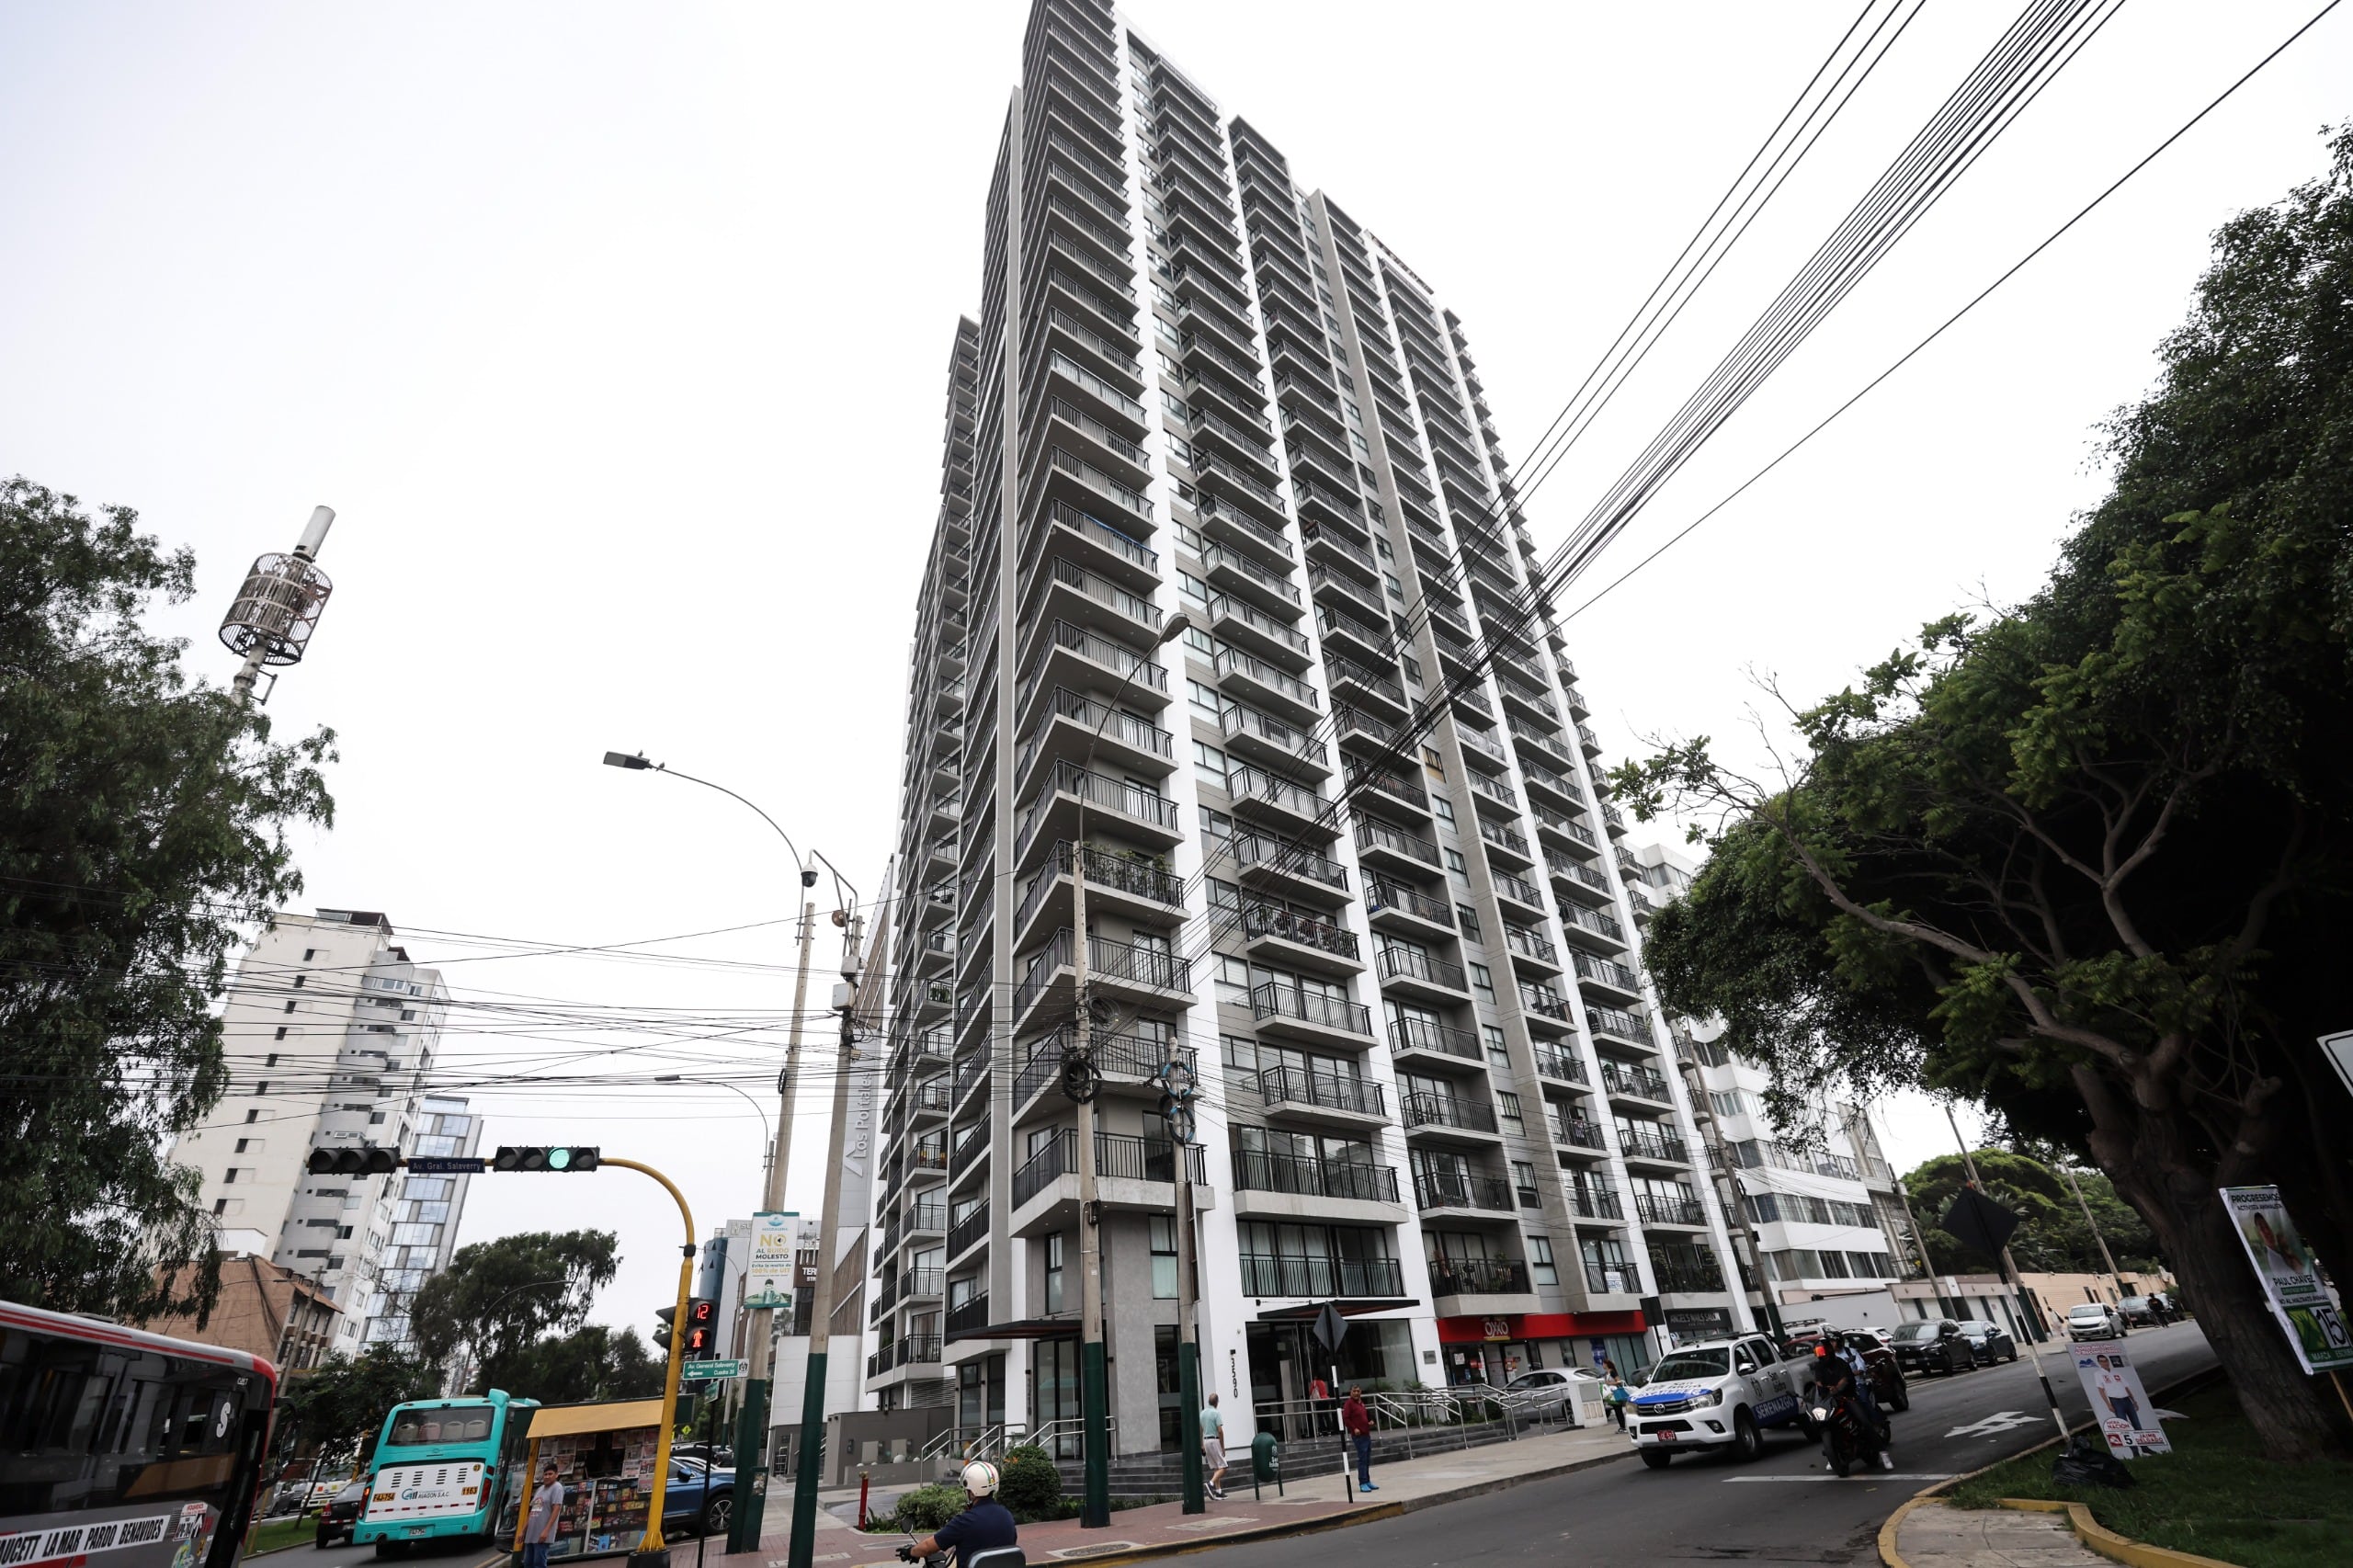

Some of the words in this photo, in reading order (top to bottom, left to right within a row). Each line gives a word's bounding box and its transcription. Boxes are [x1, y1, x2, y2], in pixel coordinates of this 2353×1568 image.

[853, 1132, 868, 1158] Los
[413, 1162, 425, 1170] Av.
[426, 1162, 445, 1170] Gral.
[447, 1162, 481, 1172] Salaverry
[2231, 1192, 2281, 1203] PROGRESEMOS
[759, 1233, 787, 1247] NO
[2272, 1276, 2290, 1288] PAUL
[697, 1304, 709, 1320] 12
[1484, 1322, 1508, 1336] OXXO
[2315, 1308, 2347, 1346] 15
[1755, 1396, 1794, 1419] SERENAZGO
[2123, 1434, 2132, 1445] 5
[461, 1486, 478, 1495] 1163
[0, 1534, 42, 1564] AUCETT
[84, 1524, 118, 1551] PARDO
[119, 1517, 165, 1545] BENAVIDES
